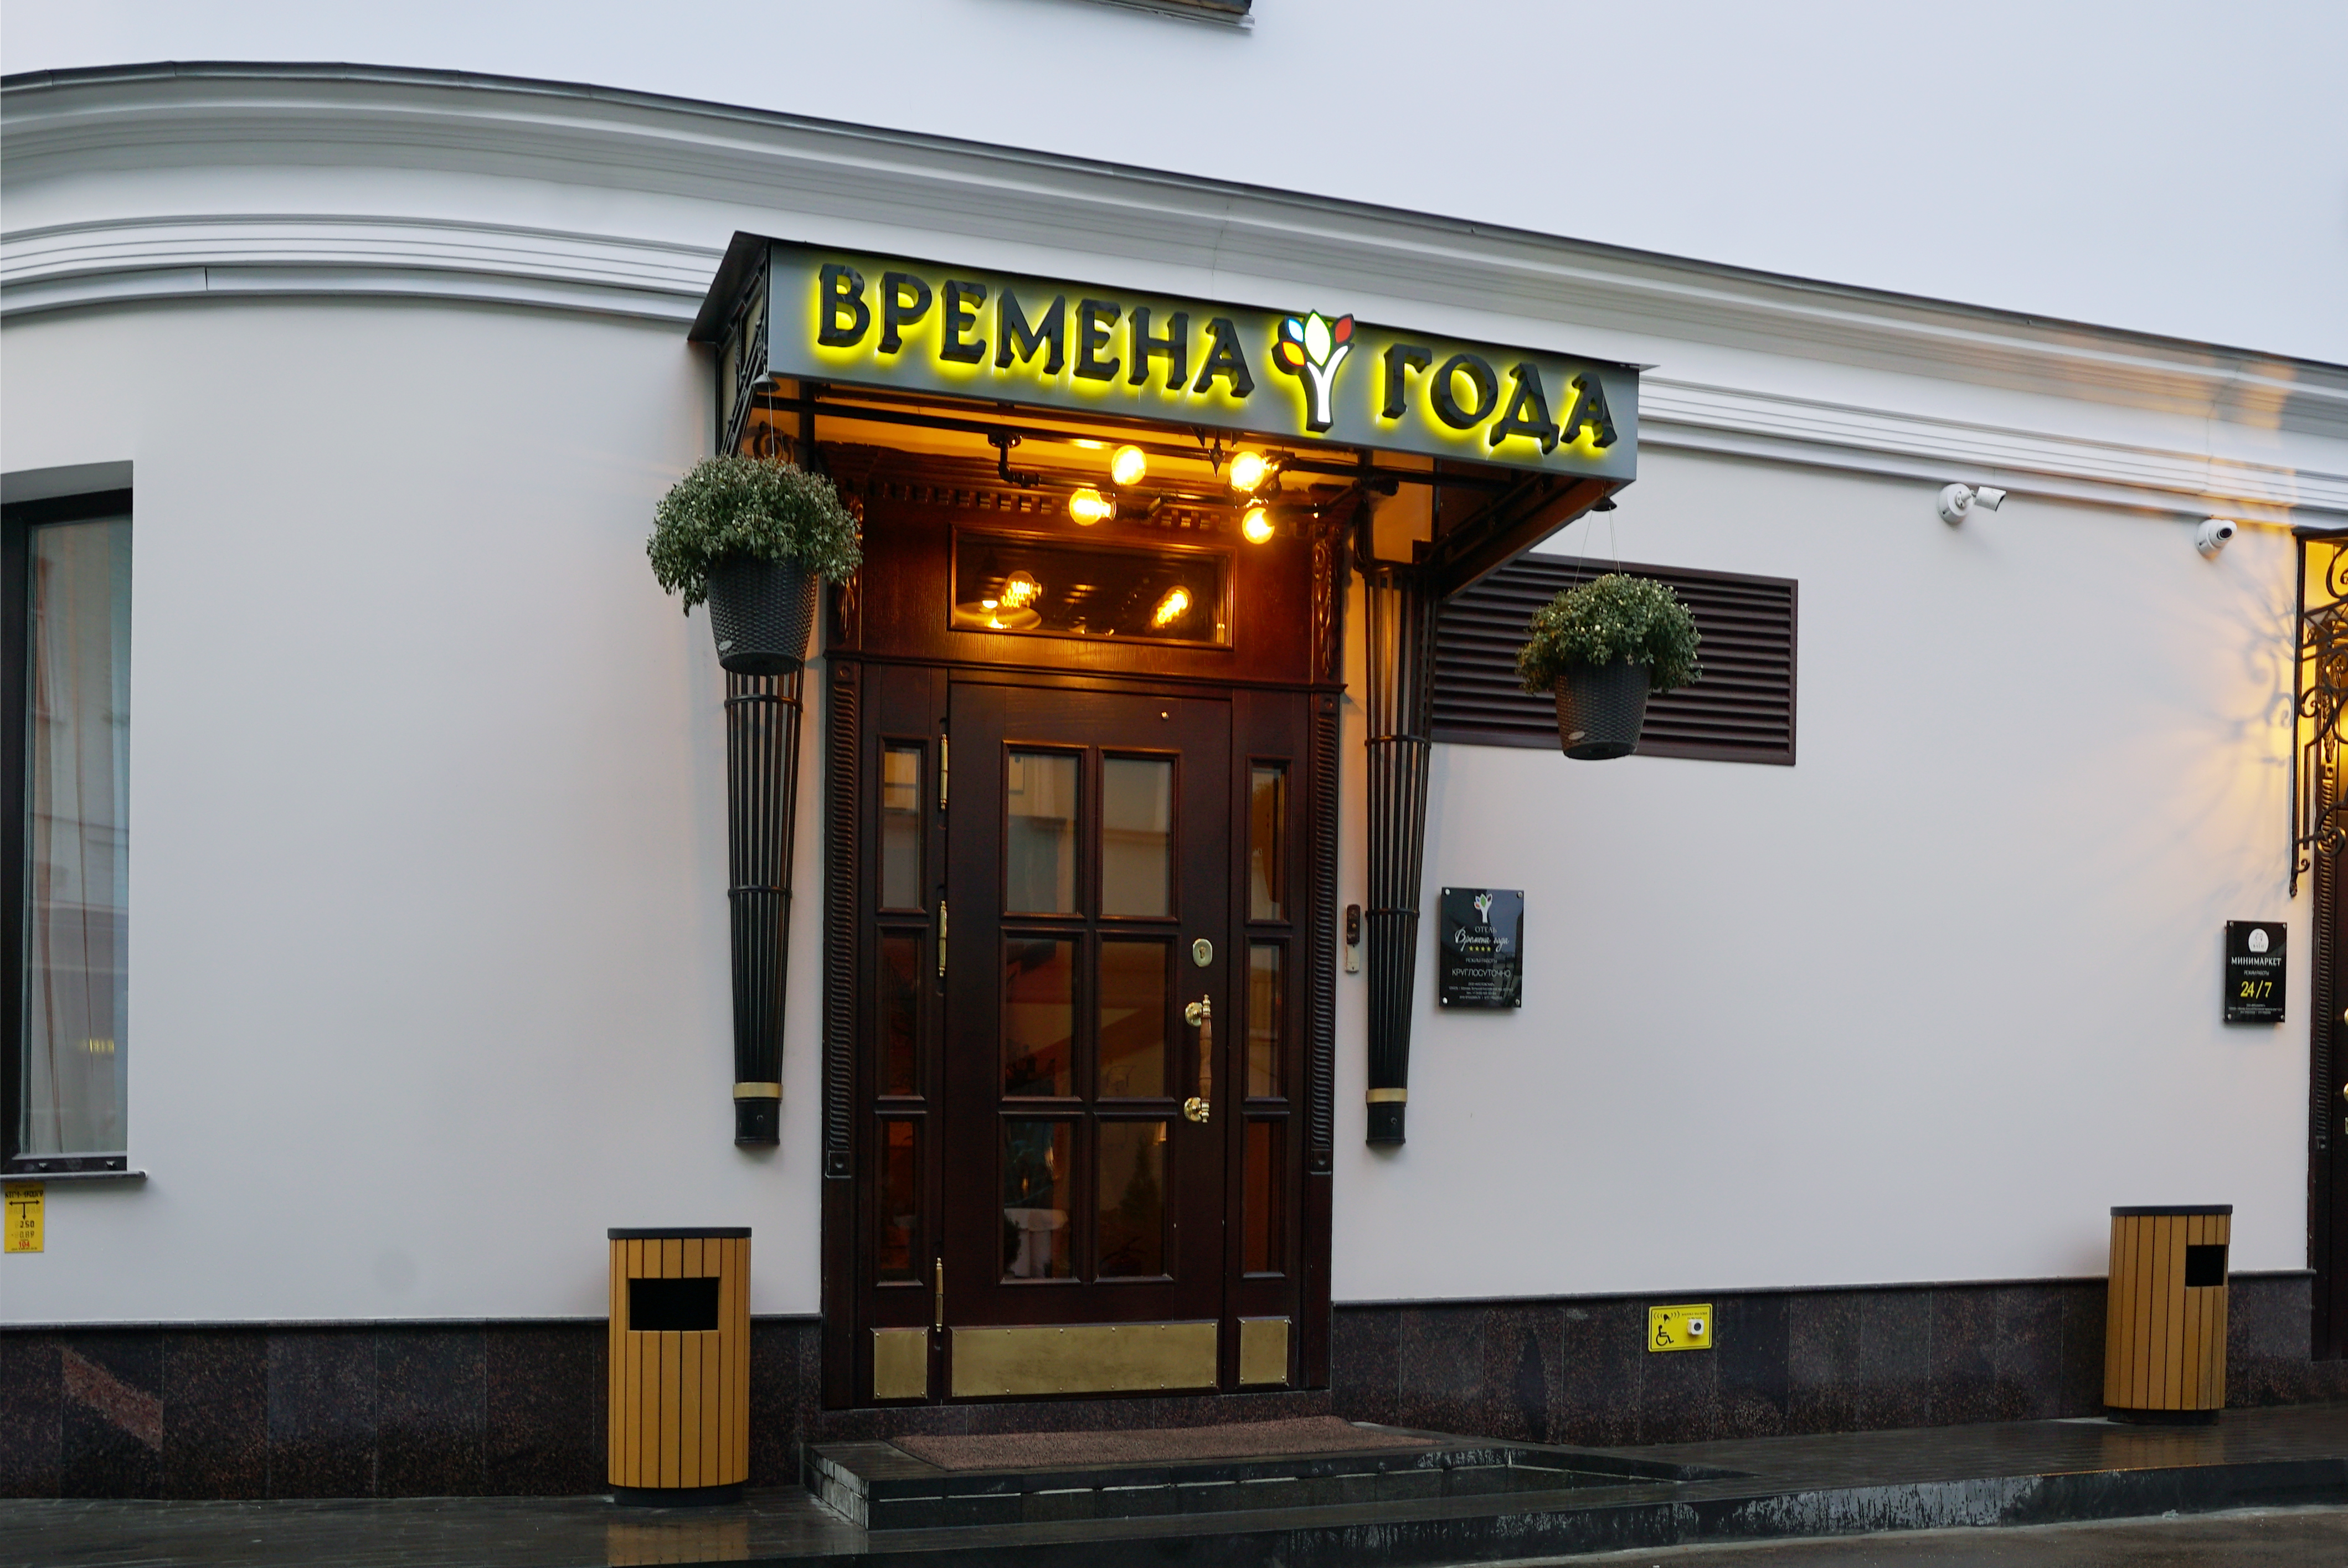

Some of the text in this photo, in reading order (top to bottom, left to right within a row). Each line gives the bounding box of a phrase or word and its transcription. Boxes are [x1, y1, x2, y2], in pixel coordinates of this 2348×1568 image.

[817, 262, 1618, 455] ВРЕМЕНА ГОДА
[1455, 926, 1491, 952] Времена
[2231, 956, 2282, 967] МИНИМАРКЕТ
[1451, 968, 1511, 977] КРУГЛОСУТОЧНО
[2240, 979, 2272, 999] 24/7
